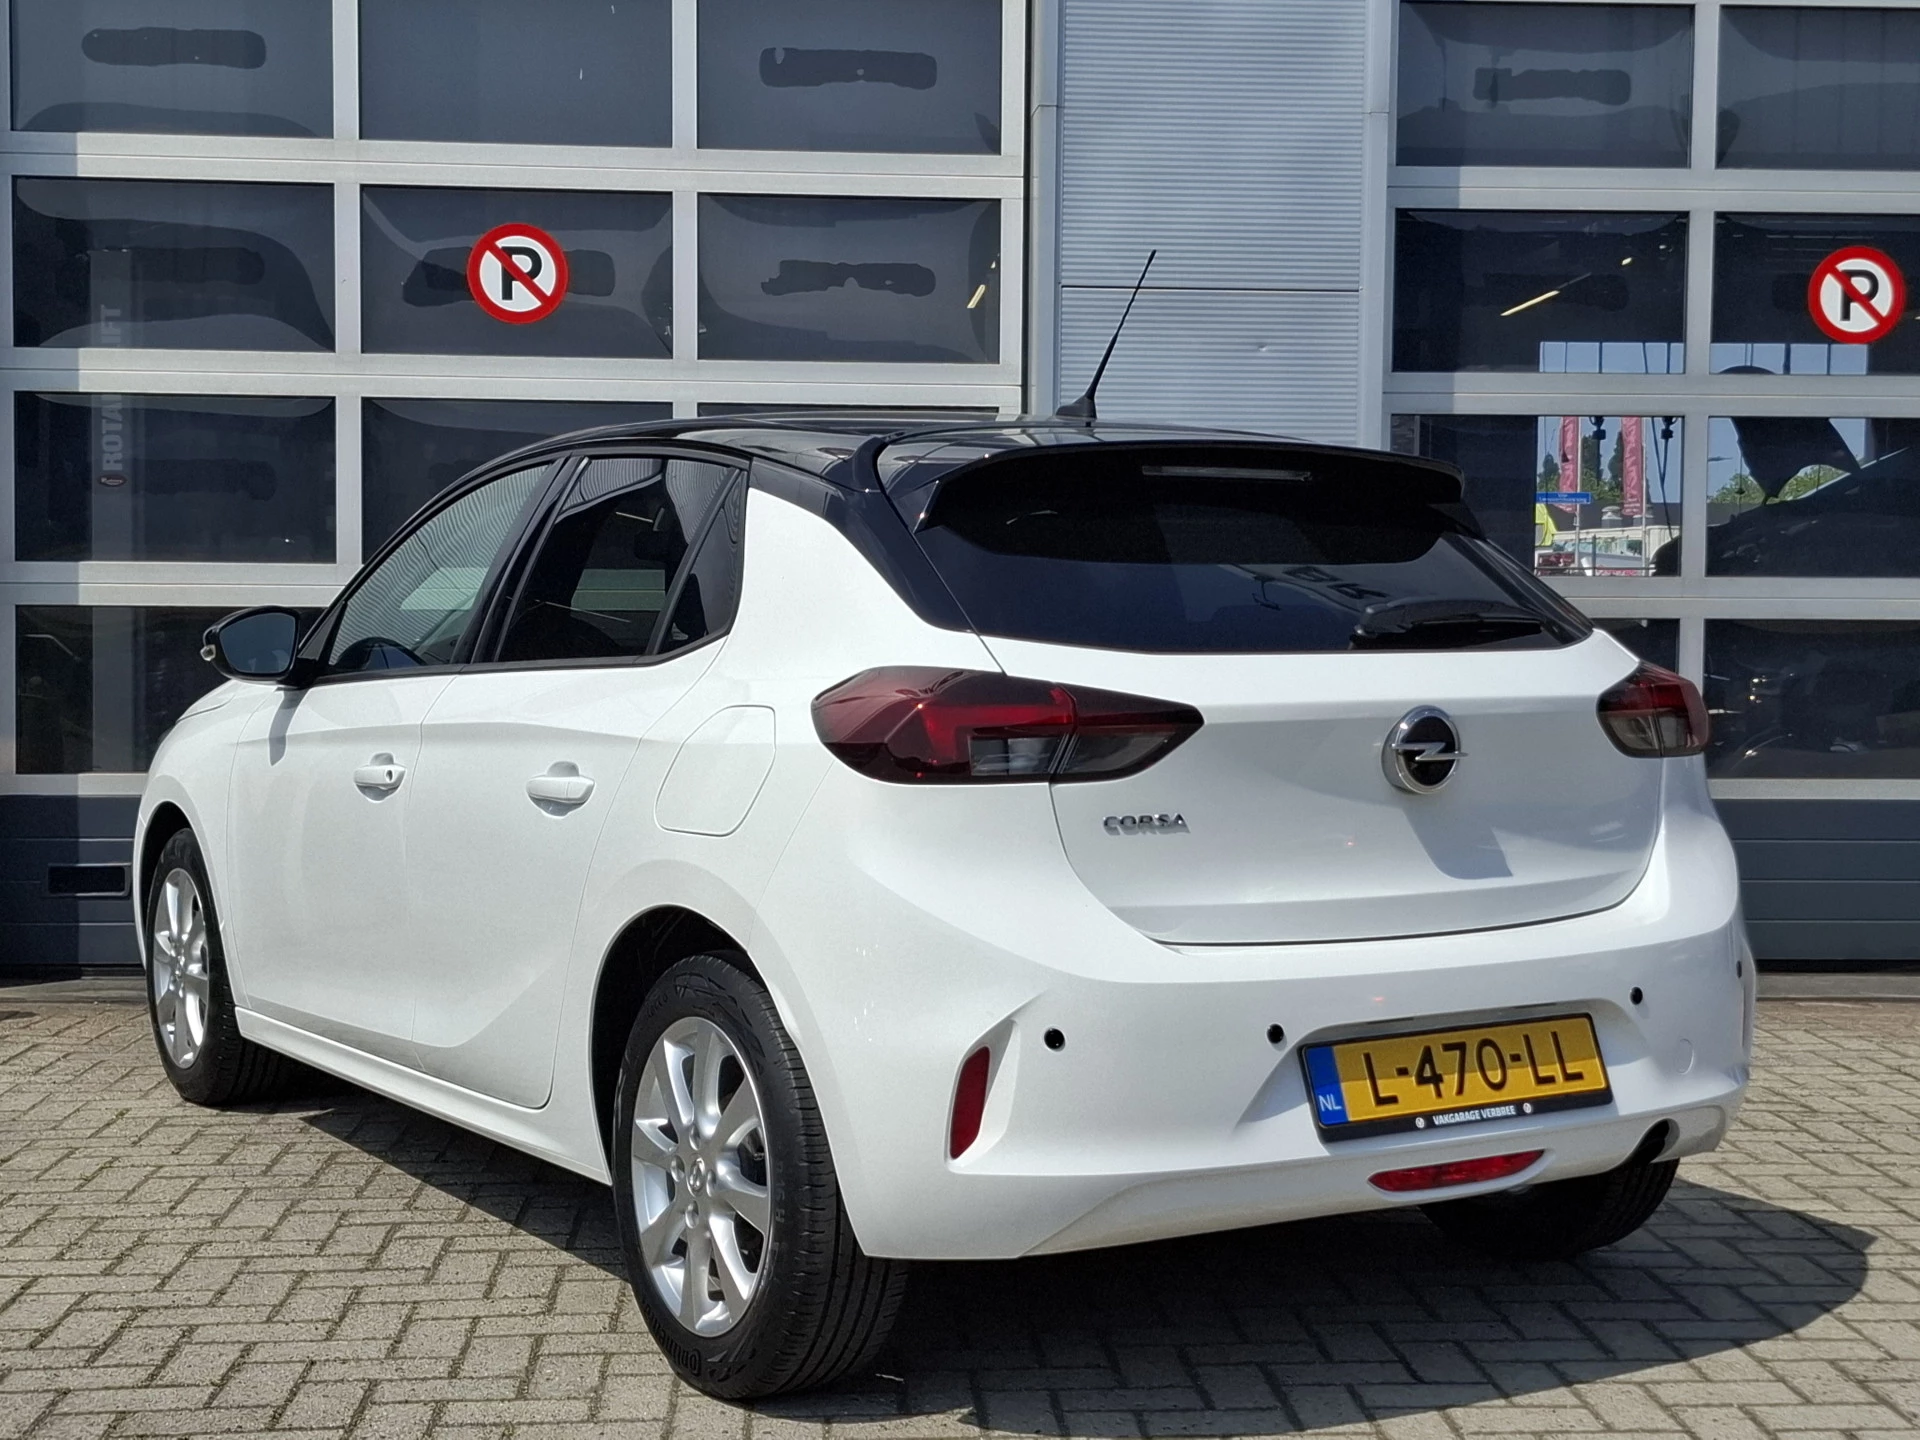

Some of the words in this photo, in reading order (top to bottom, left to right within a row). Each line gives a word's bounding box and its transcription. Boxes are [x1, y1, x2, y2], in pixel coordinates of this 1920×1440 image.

[1103, 813, 1191, 836] CORSA
[1361, 1030, 1584, 1107] L-470-LL
[1317, 1093, 1342, 1112] NL
[1432, 1109, 1481, 1126] VAKGARAGE
[1480, 1105, 1516, 1120] VERBREE
